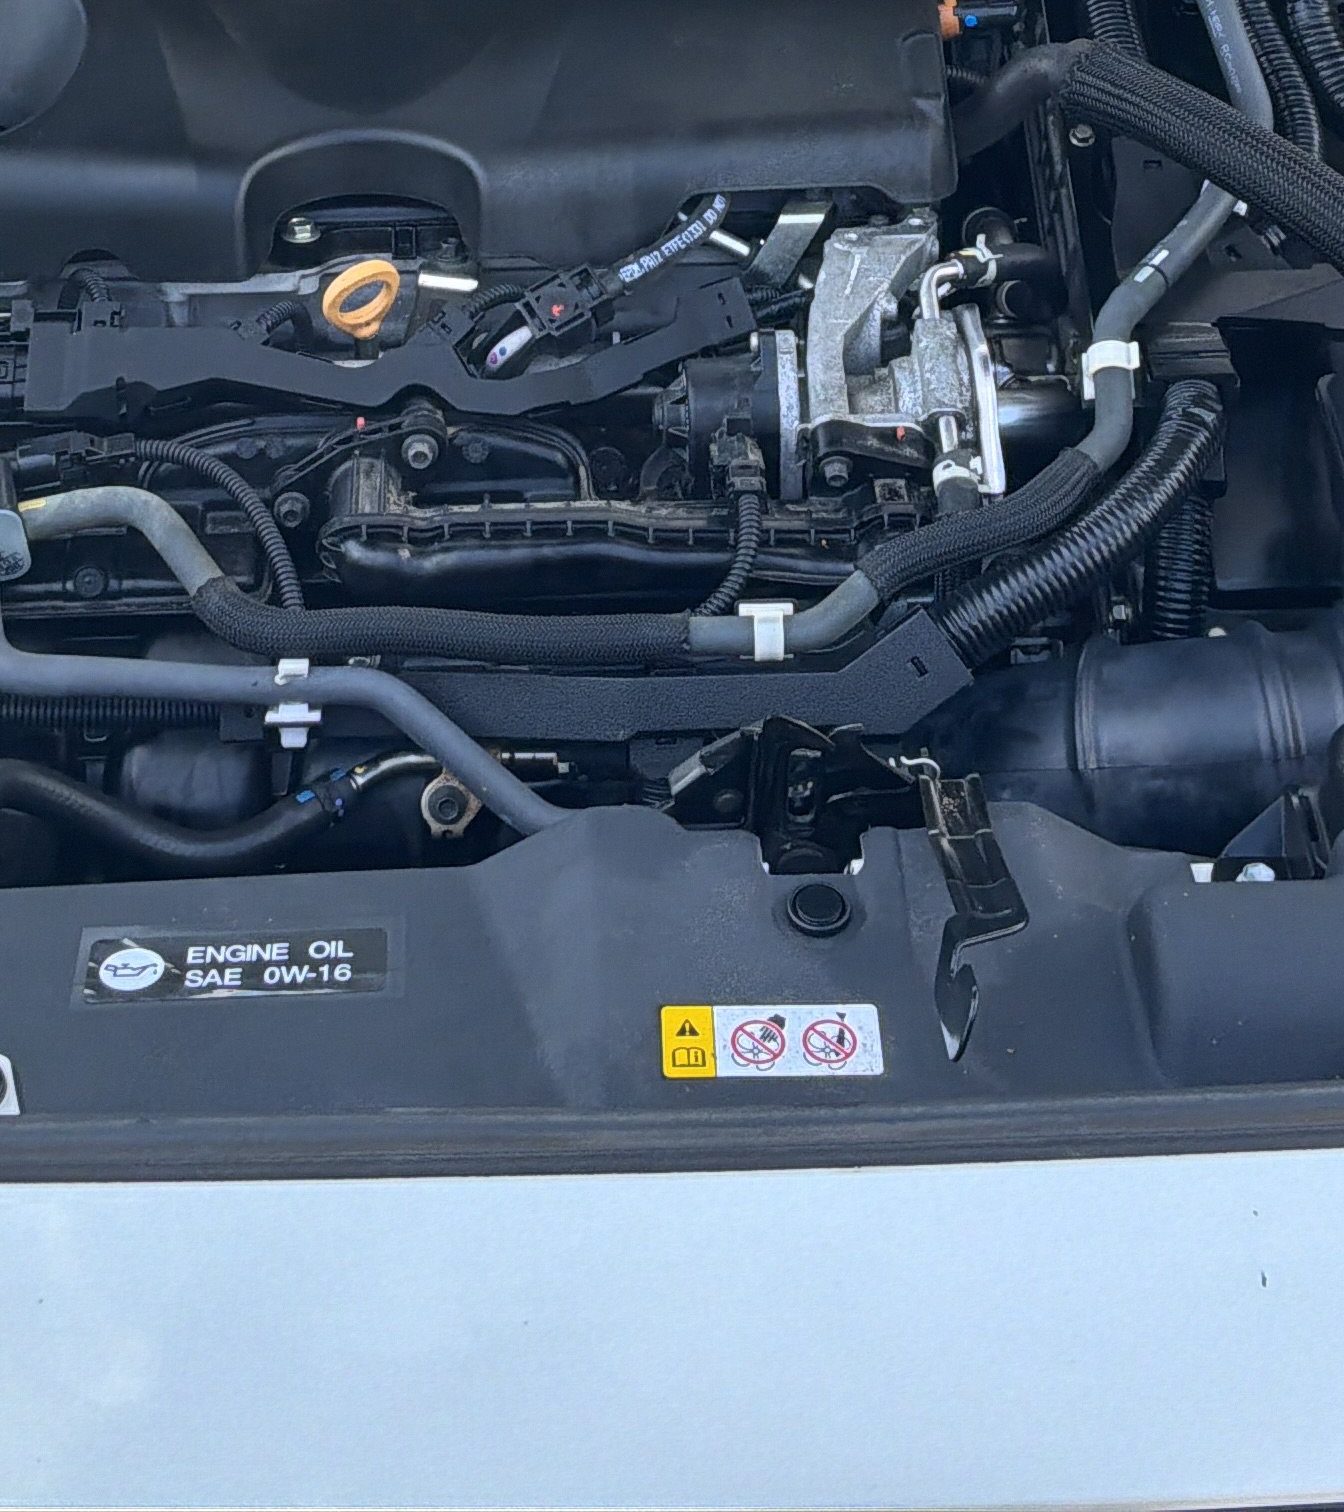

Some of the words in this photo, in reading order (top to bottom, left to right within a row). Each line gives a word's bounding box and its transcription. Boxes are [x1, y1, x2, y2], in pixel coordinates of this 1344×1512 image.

[186, 943, 290, 964] ENGINE
[308, 940, 354, 960] OIL
[185, 968, 243, 988] SAE
[263, 963, 353, 984] 0W-16
